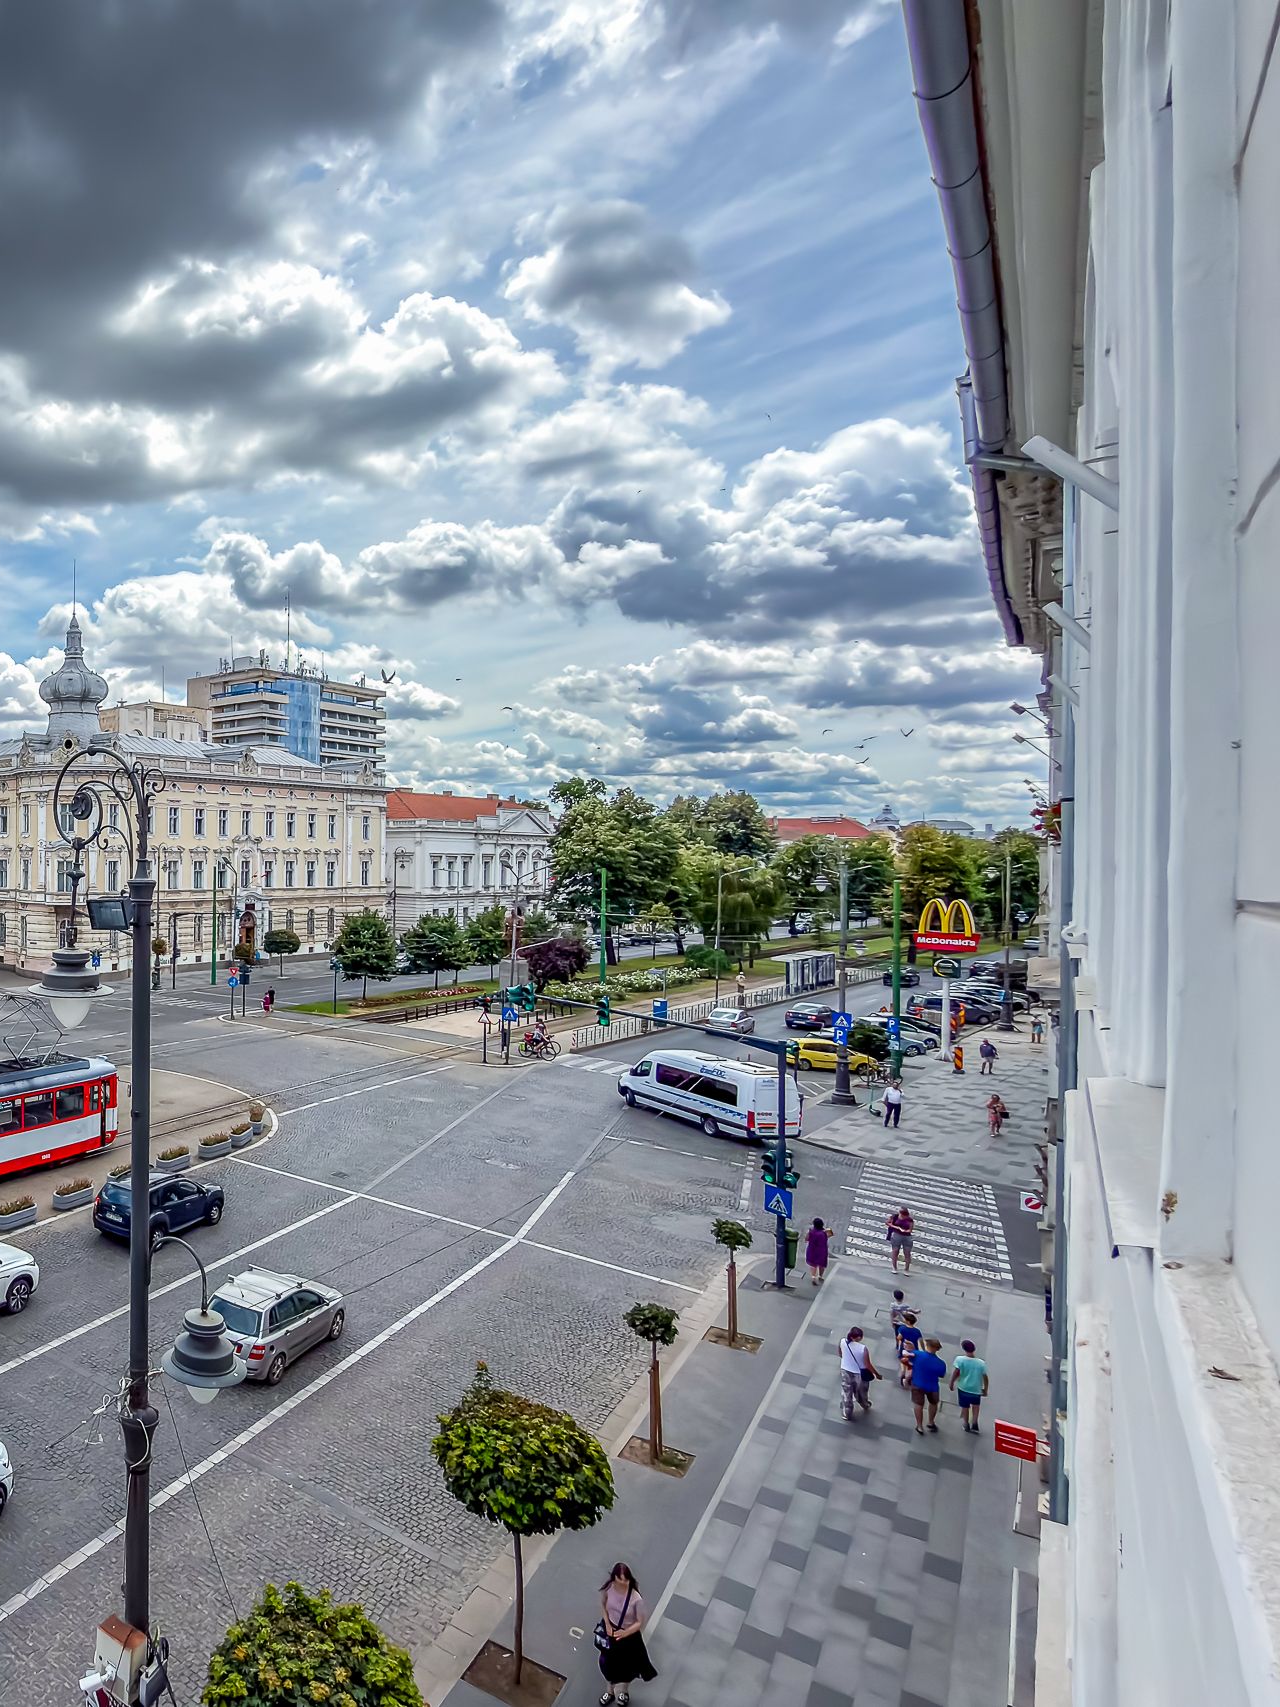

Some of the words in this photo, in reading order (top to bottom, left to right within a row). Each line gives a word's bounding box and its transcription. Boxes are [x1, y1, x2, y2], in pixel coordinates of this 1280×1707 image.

[916, 936, 976, 947] McDonald's
[888, 1019, 895, 1028] P
[836, 1030, 844, 1040] P
